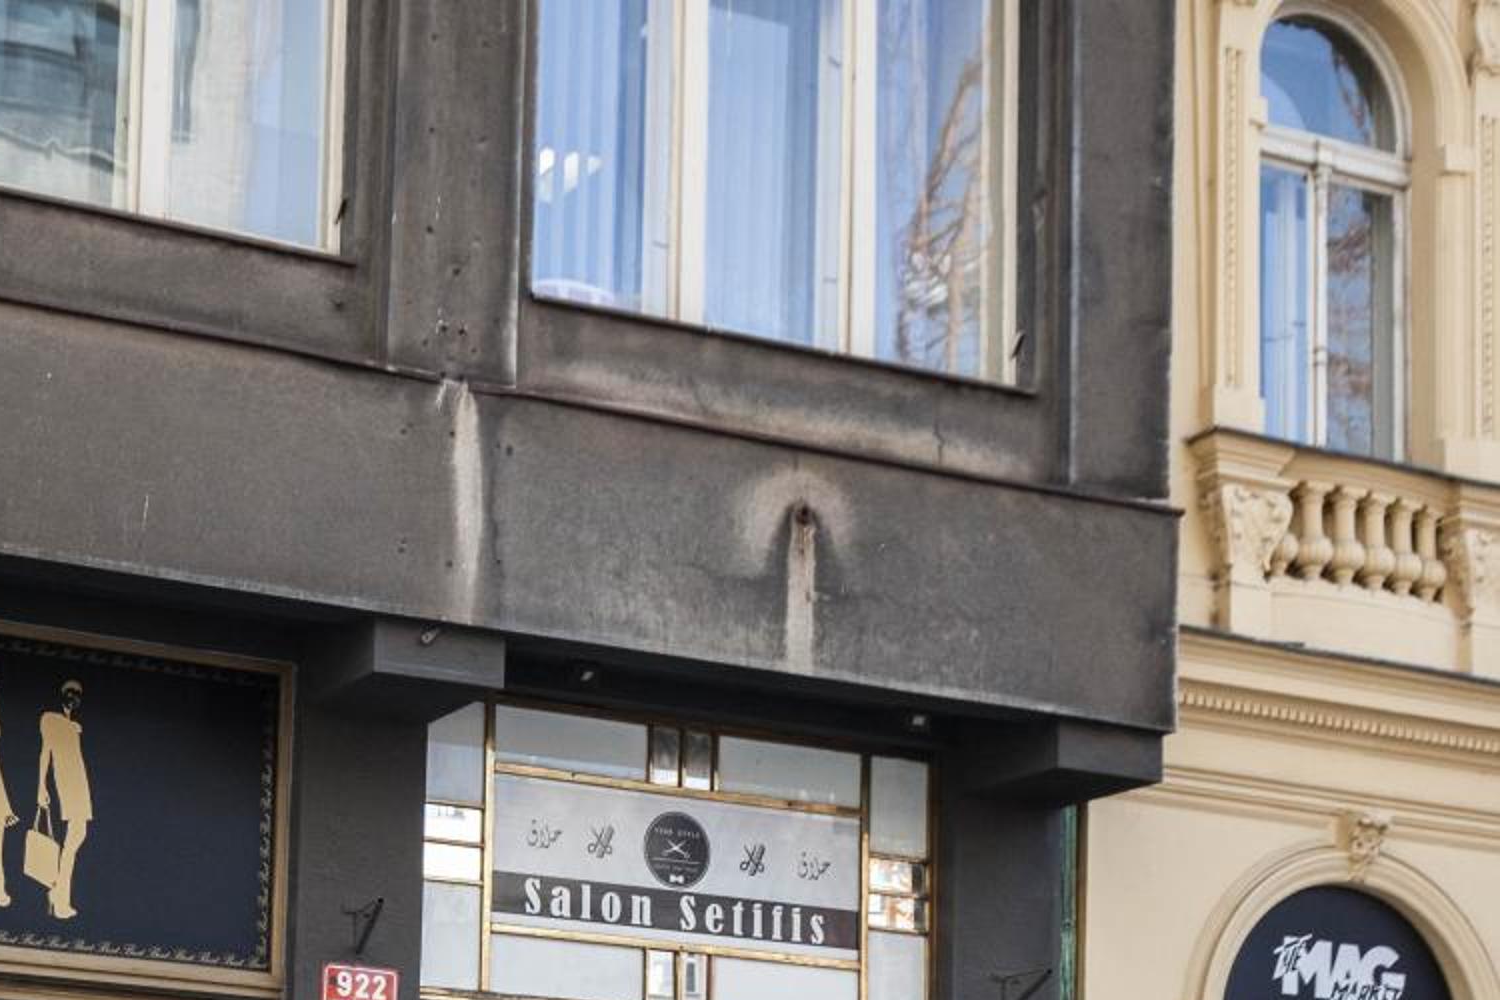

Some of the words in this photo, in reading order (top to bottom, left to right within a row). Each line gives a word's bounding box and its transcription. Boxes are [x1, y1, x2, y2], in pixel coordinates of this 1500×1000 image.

[523, 877, 654, 926] Salon
[678, 894, 826, 945] Setifis
[336, 971, 387, 1000] 922
[1282, 936, 1407, 1000] MAG
